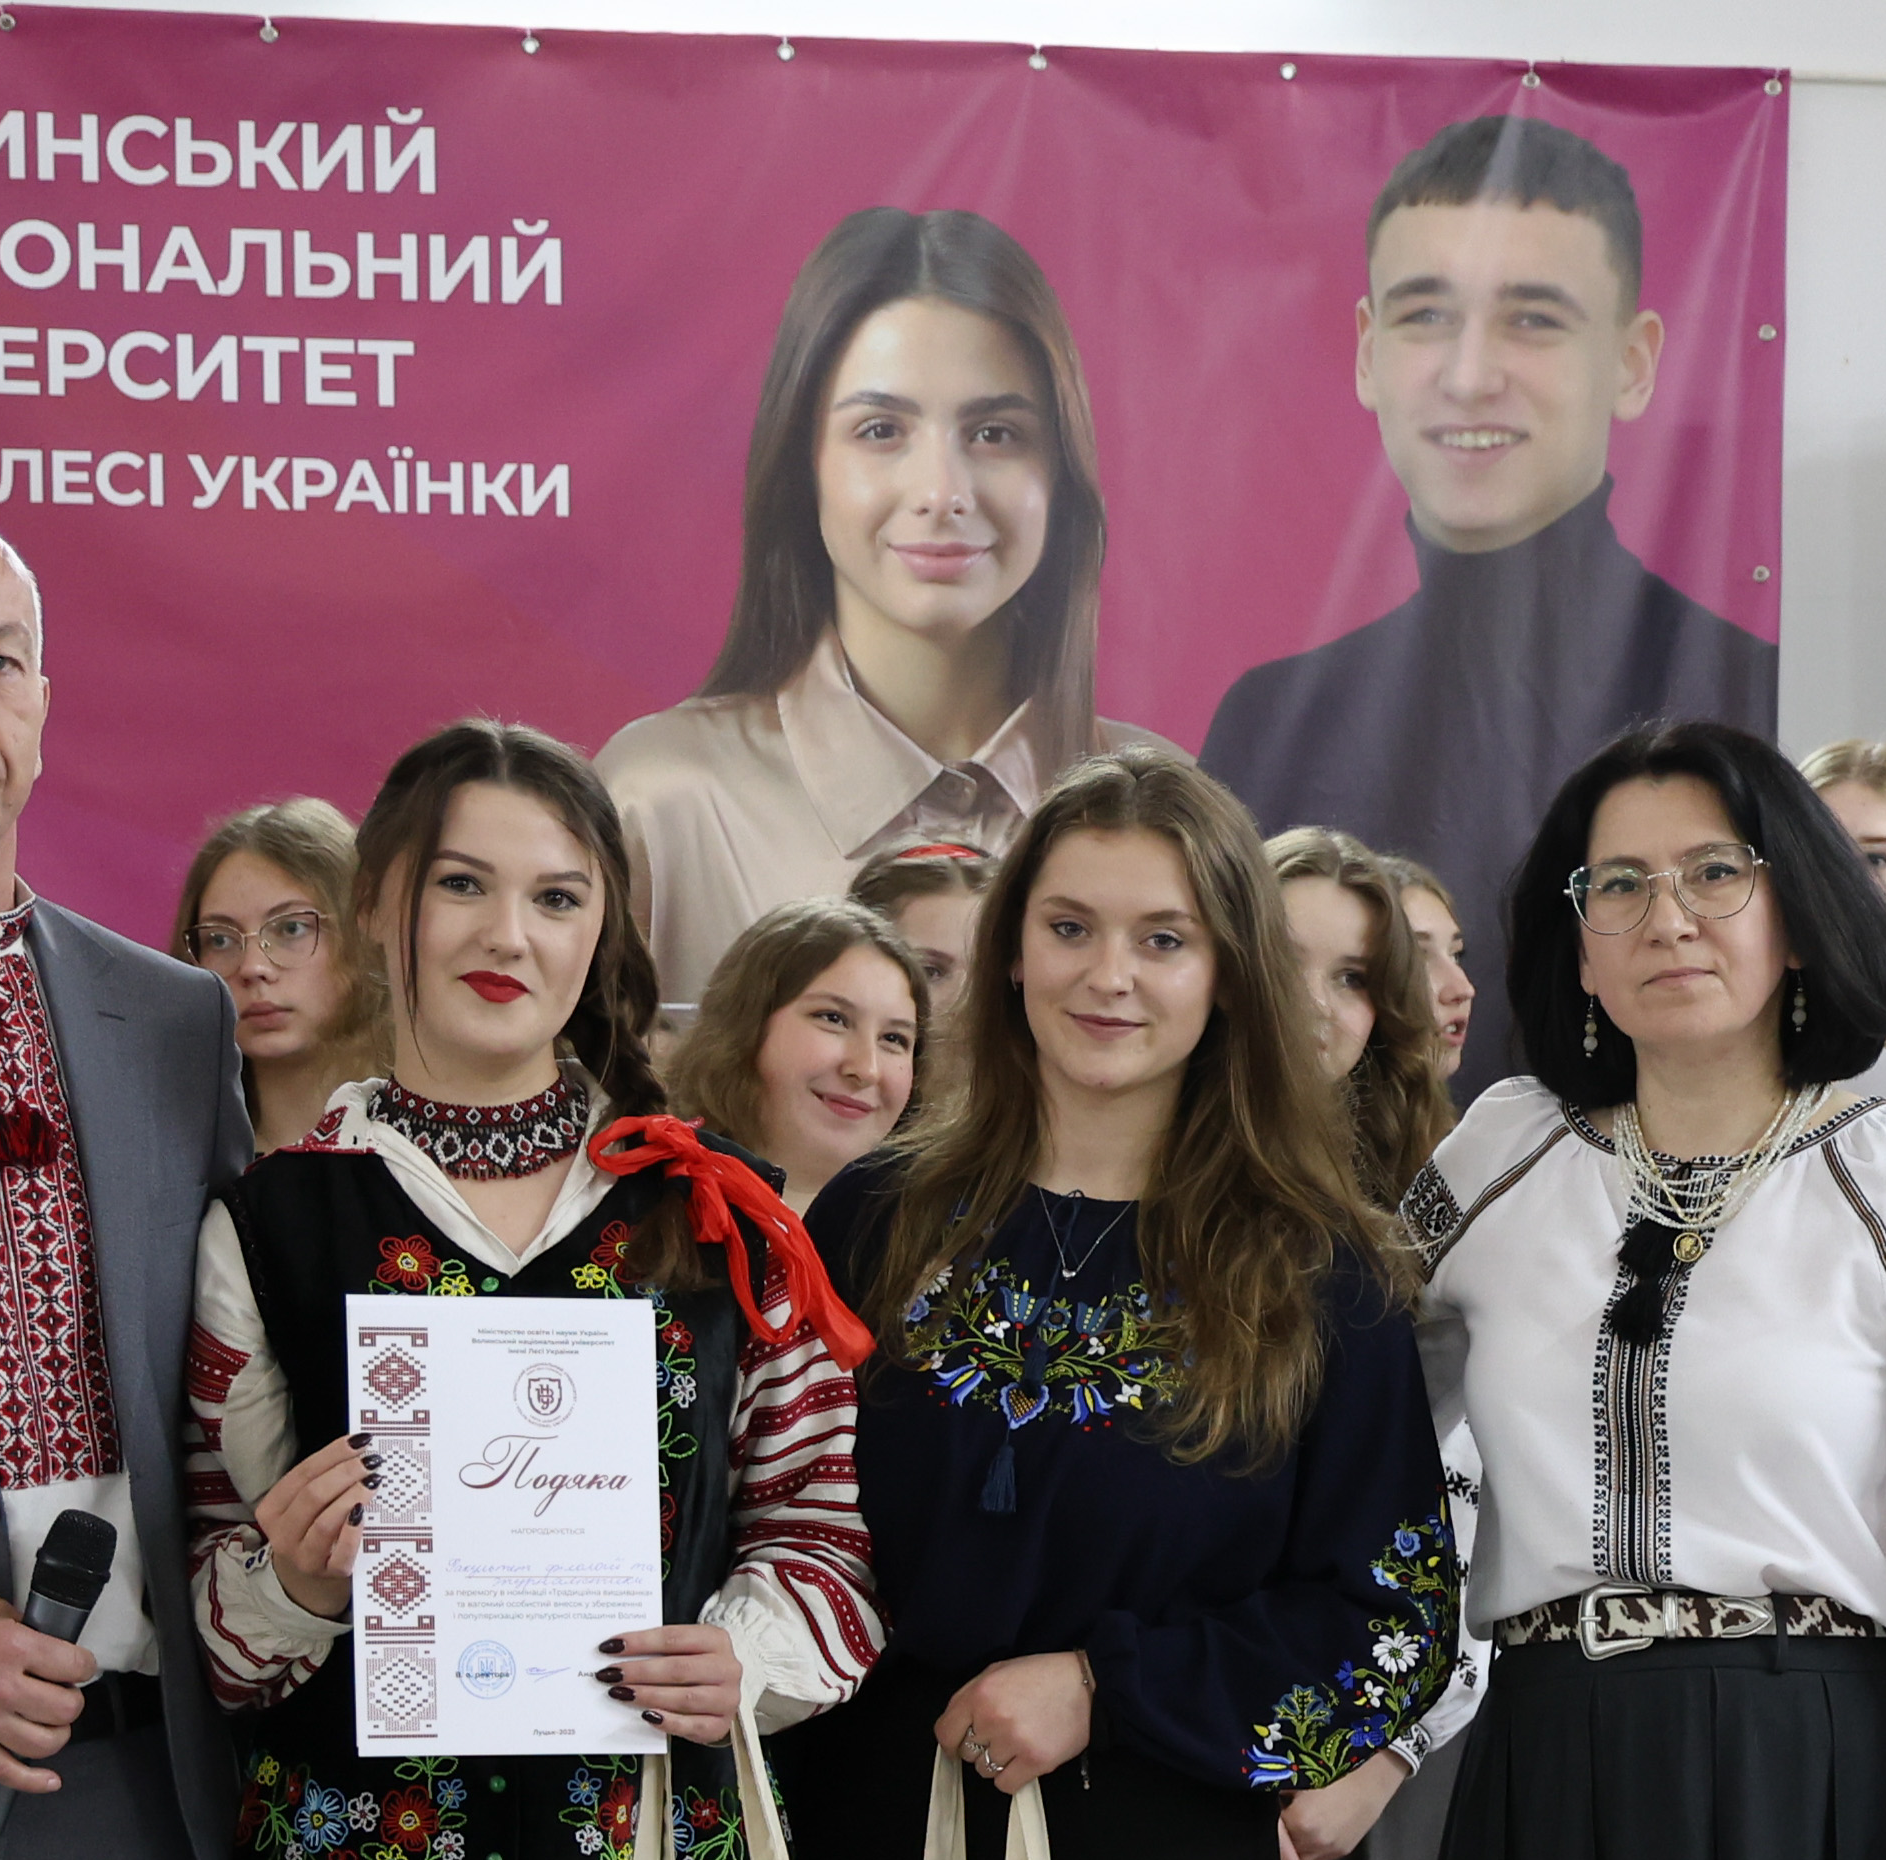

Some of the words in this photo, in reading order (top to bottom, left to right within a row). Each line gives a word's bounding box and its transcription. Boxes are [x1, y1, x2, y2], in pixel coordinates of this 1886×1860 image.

[187, 449, 570, 518] УКРАЇНКИ
[458, 1434, 634, 1518] Подяка
[510, 1526, 586, 1536] НАГОРОДЖУЄТЬСЯ
[456, 1590, 498, 1598] перемогу
